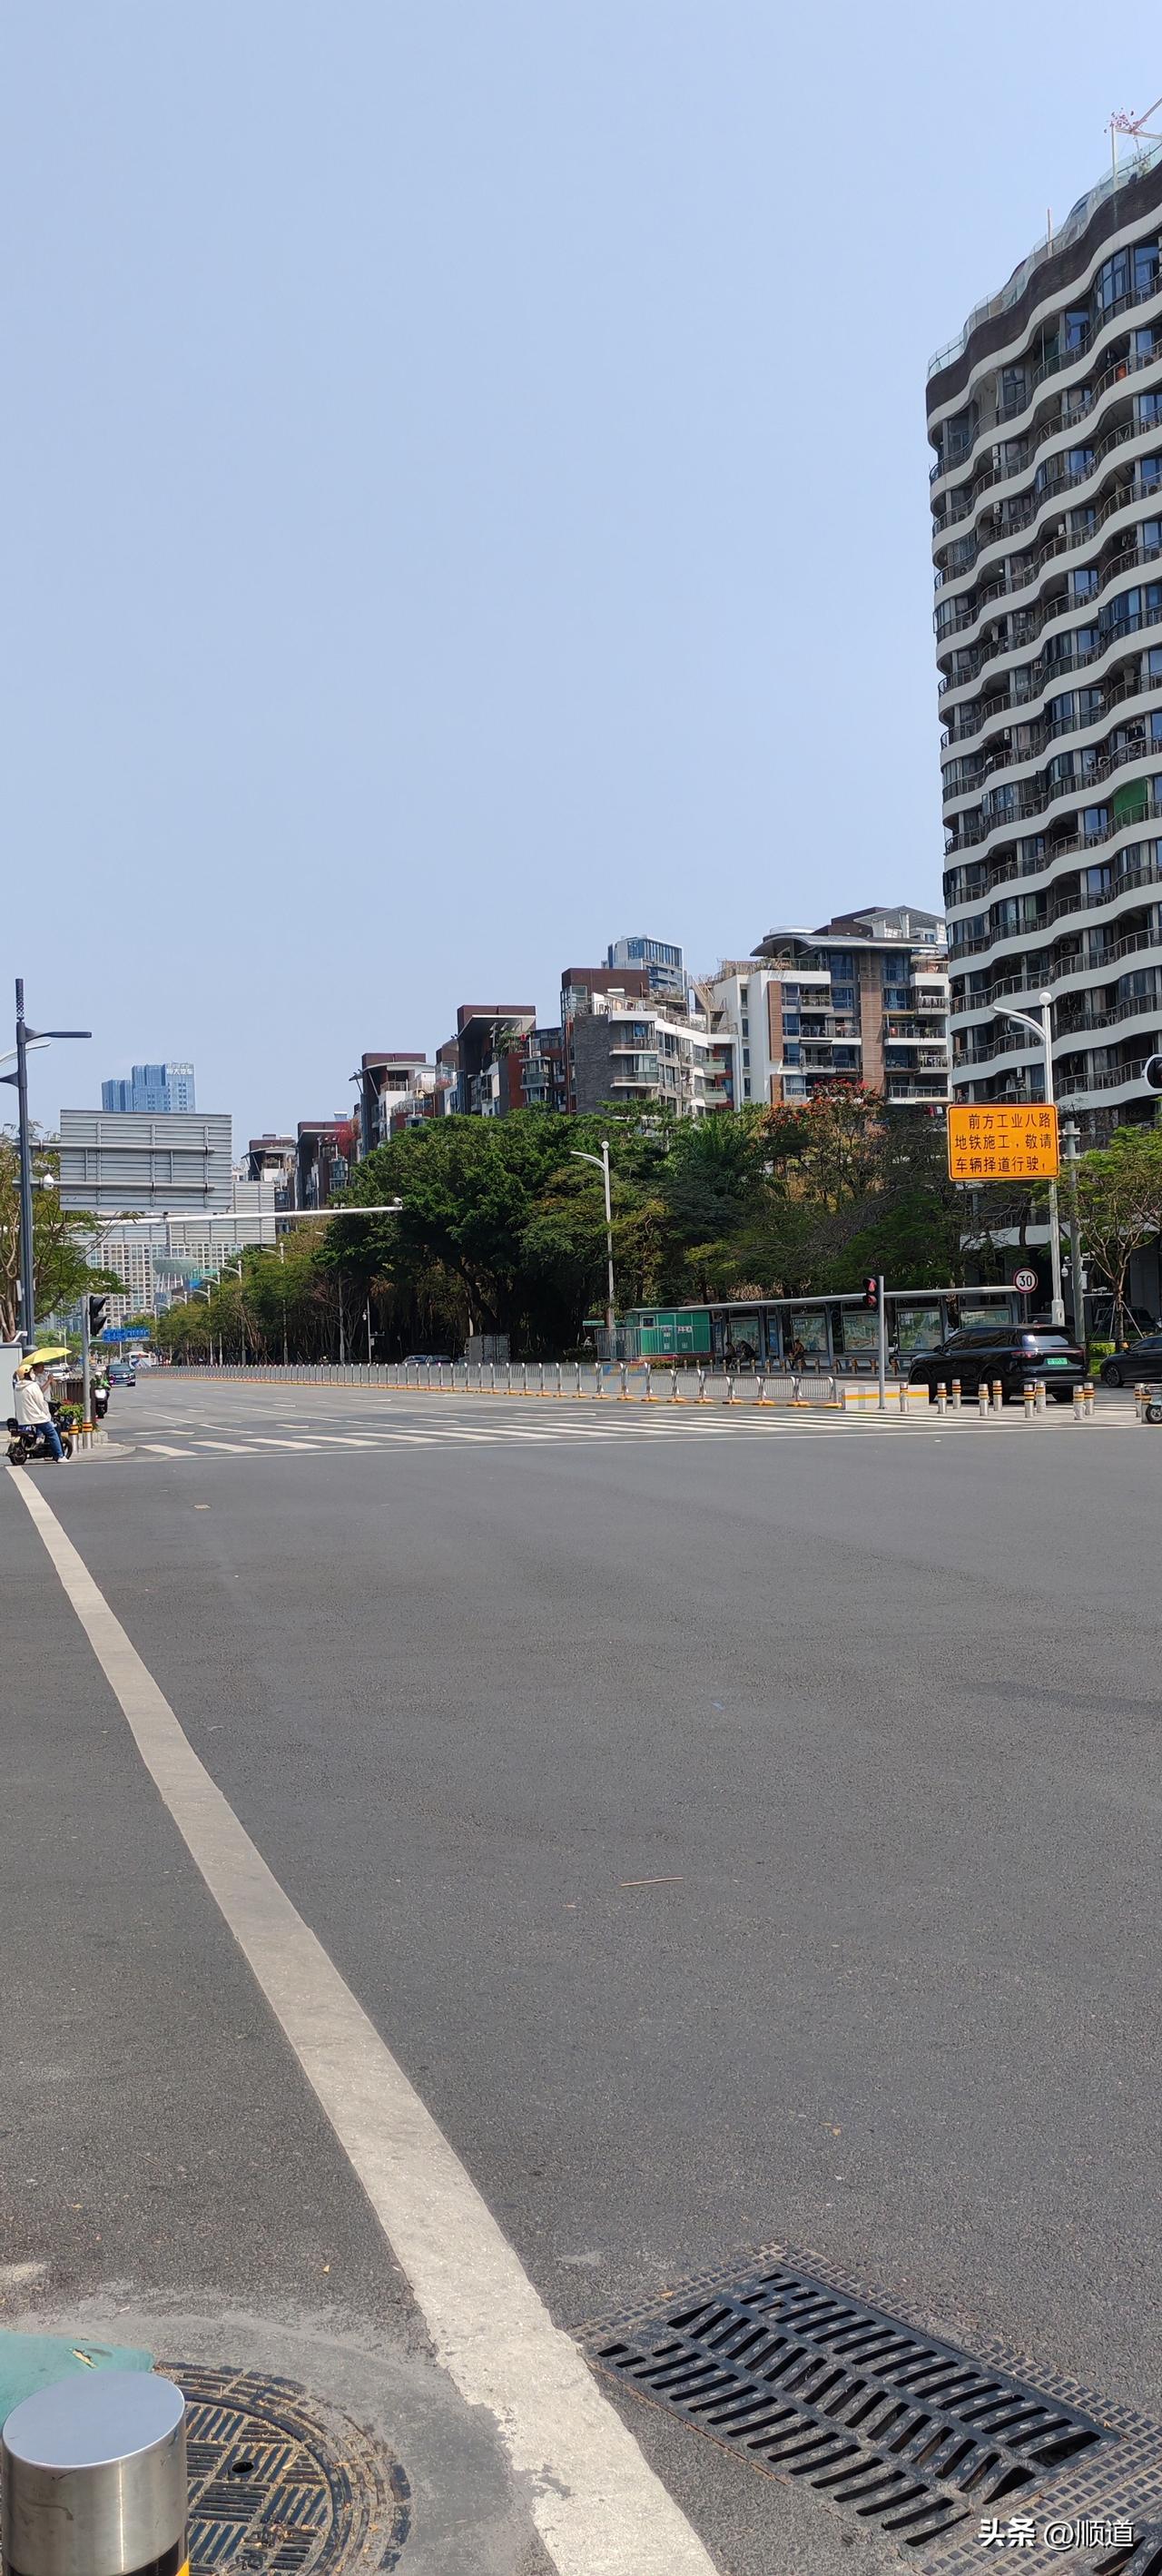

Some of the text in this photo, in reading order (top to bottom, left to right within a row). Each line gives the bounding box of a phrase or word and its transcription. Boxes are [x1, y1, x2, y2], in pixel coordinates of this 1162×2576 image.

[969, 1112, 1050, 1130] 前方工业八路
[1019, 1275, 1032, 1288] 30
